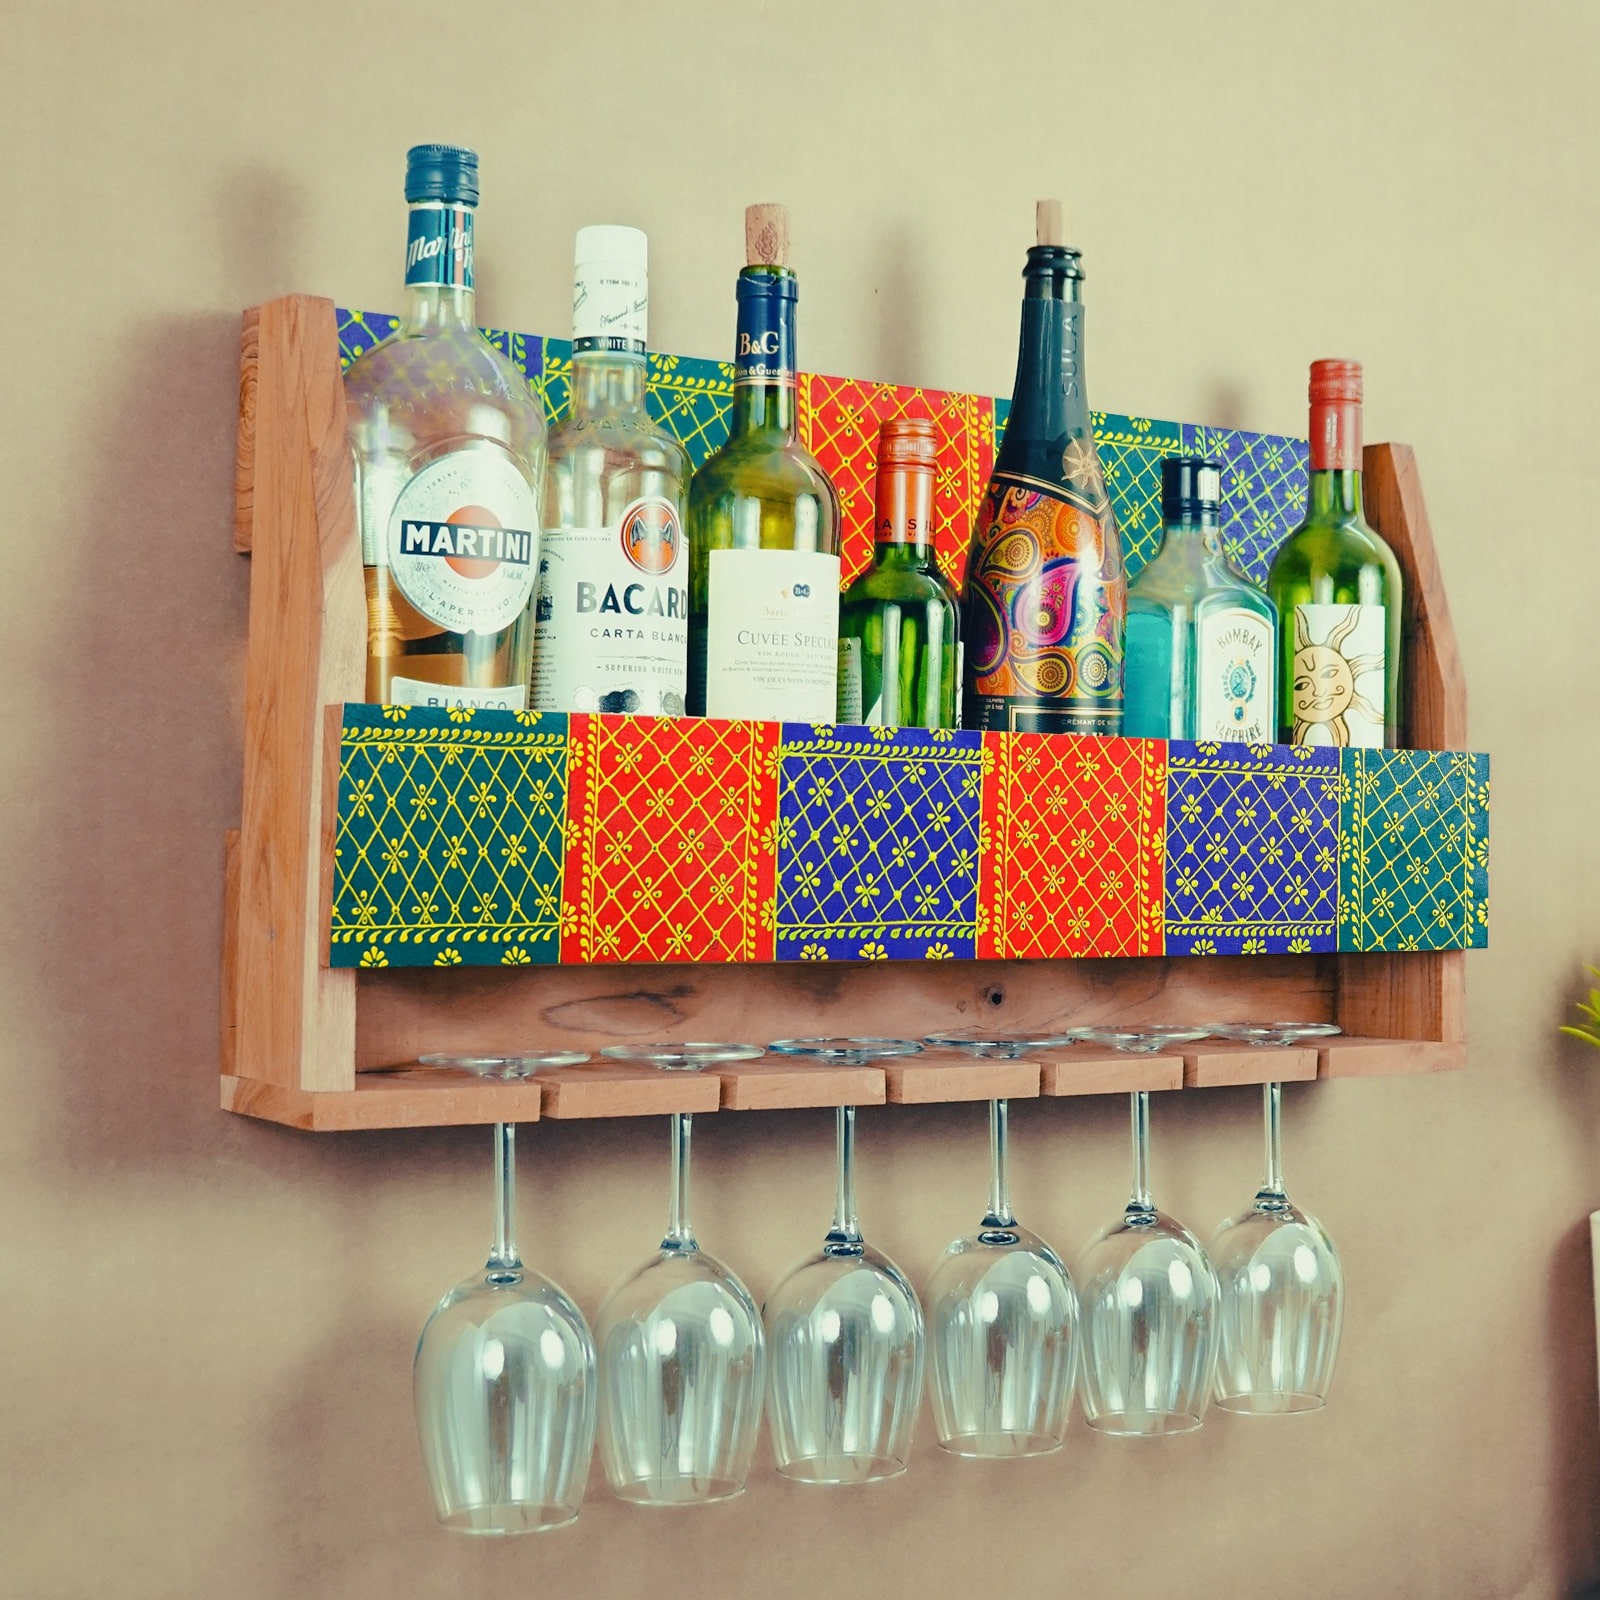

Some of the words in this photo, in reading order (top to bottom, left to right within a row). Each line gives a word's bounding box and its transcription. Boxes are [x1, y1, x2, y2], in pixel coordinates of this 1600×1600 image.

[599, 338, 627, 350] WHITE
[740, 331, 779, 355] B&G
[1062, 315, 1078, 398] SULA
[405, 523, 528, 562] MARTINI
[577, 581, 688, 620] BACARD
[590, 628, 645, 639] CARTA
[652, 631, 687, 645] BLANC
[737, 630, 789, 646] CUVÉE
[1216, 628, 1263, 656] BOMBAY
[605, 664, 647, 673] SUPERIOR
[1216, 718, 1263, 742] SAPPHIRE
